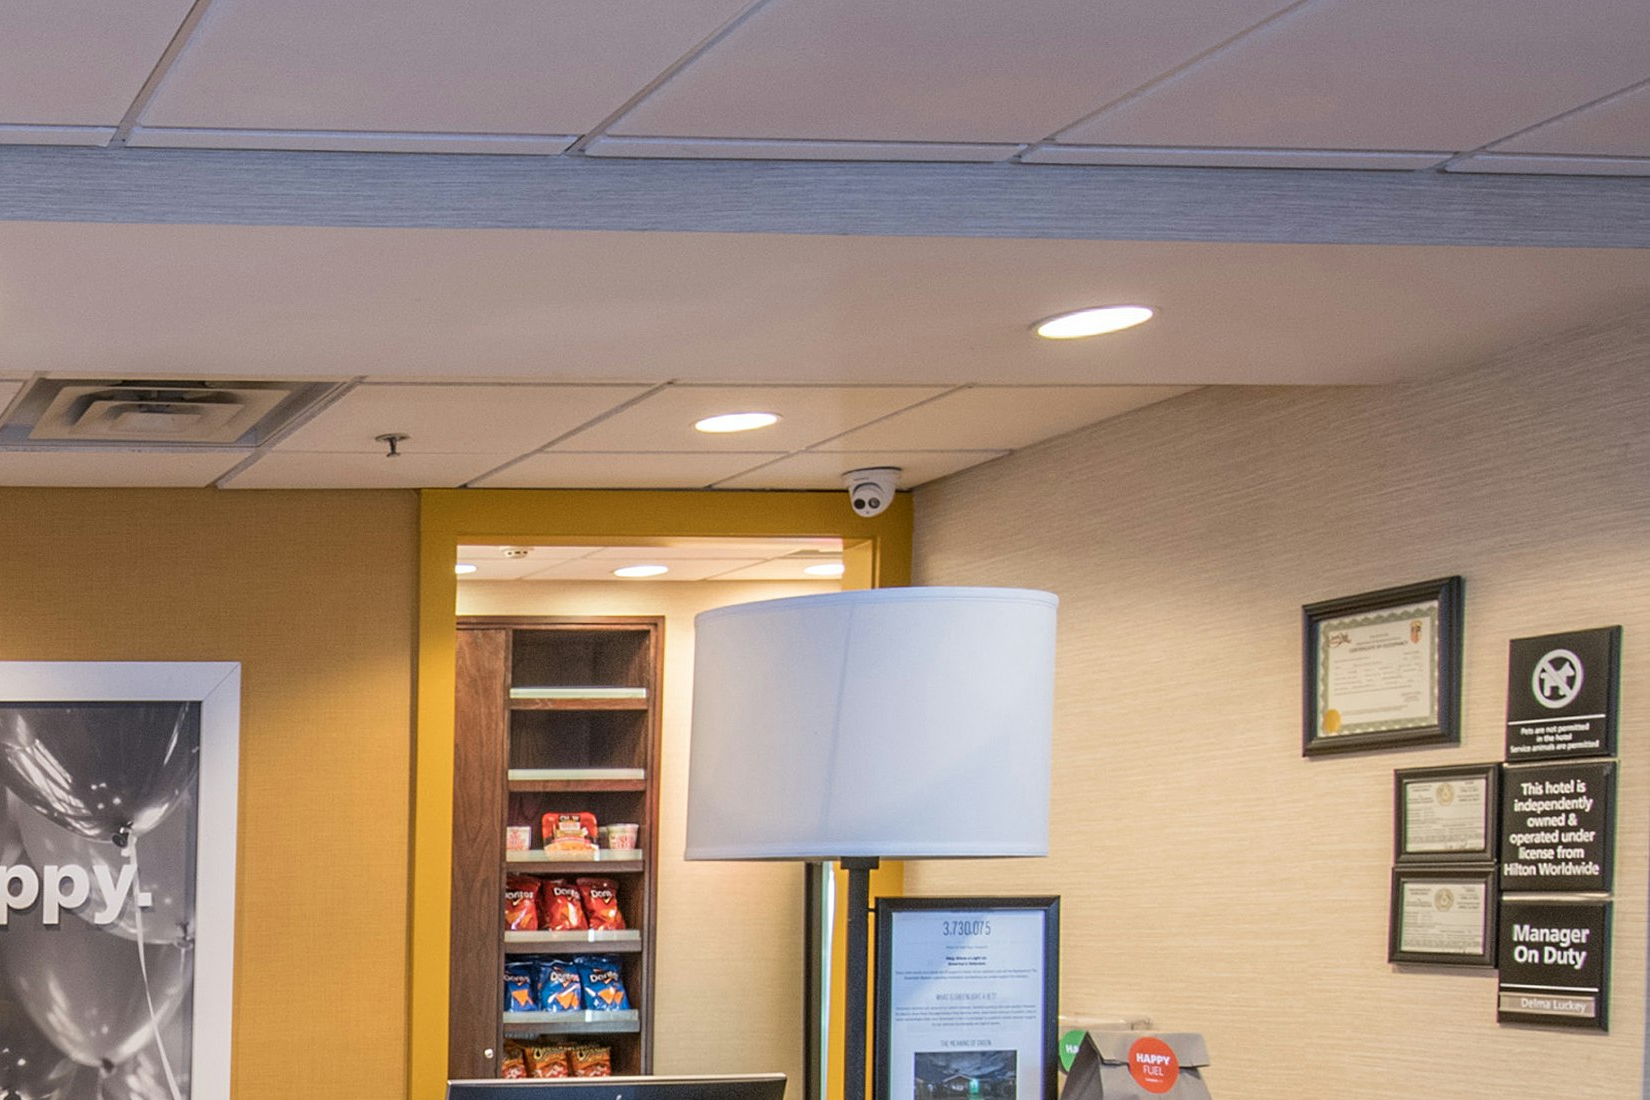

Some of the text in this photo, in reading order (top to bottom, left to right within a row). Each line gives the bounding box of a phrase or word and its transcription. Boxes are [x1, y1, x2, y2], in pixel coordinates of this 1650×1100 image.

[1520, 727, 1534, 735] Pets
[1546, 725, 1557, 734] not
[1558, 723, 1590, 734] permitted
[1536, 732, 1572, 742] in the hotel
[1510, 740, 1600, 753] Service animals are permitted
[1521, 779, 1586, 796] This hotel is
[1514, 796, 1593, 814] independently
[1526, 813, 1578, 827] owned &
[1509, 829, 1596, 846] operated under
[1518, 845, 1584, 860] license from
[1504, 862, 1600, 876] Hilton Worldwide
[1513, 924, 1590, 947] Manager
[1514, 946, 1587, 969] On Duty
[1521, 998, 1587, 1013] Delma Luckey
[1136, 1053, 1170, 1066] HAPPY
[1143, 1065, 1164, 1076] FUEL
